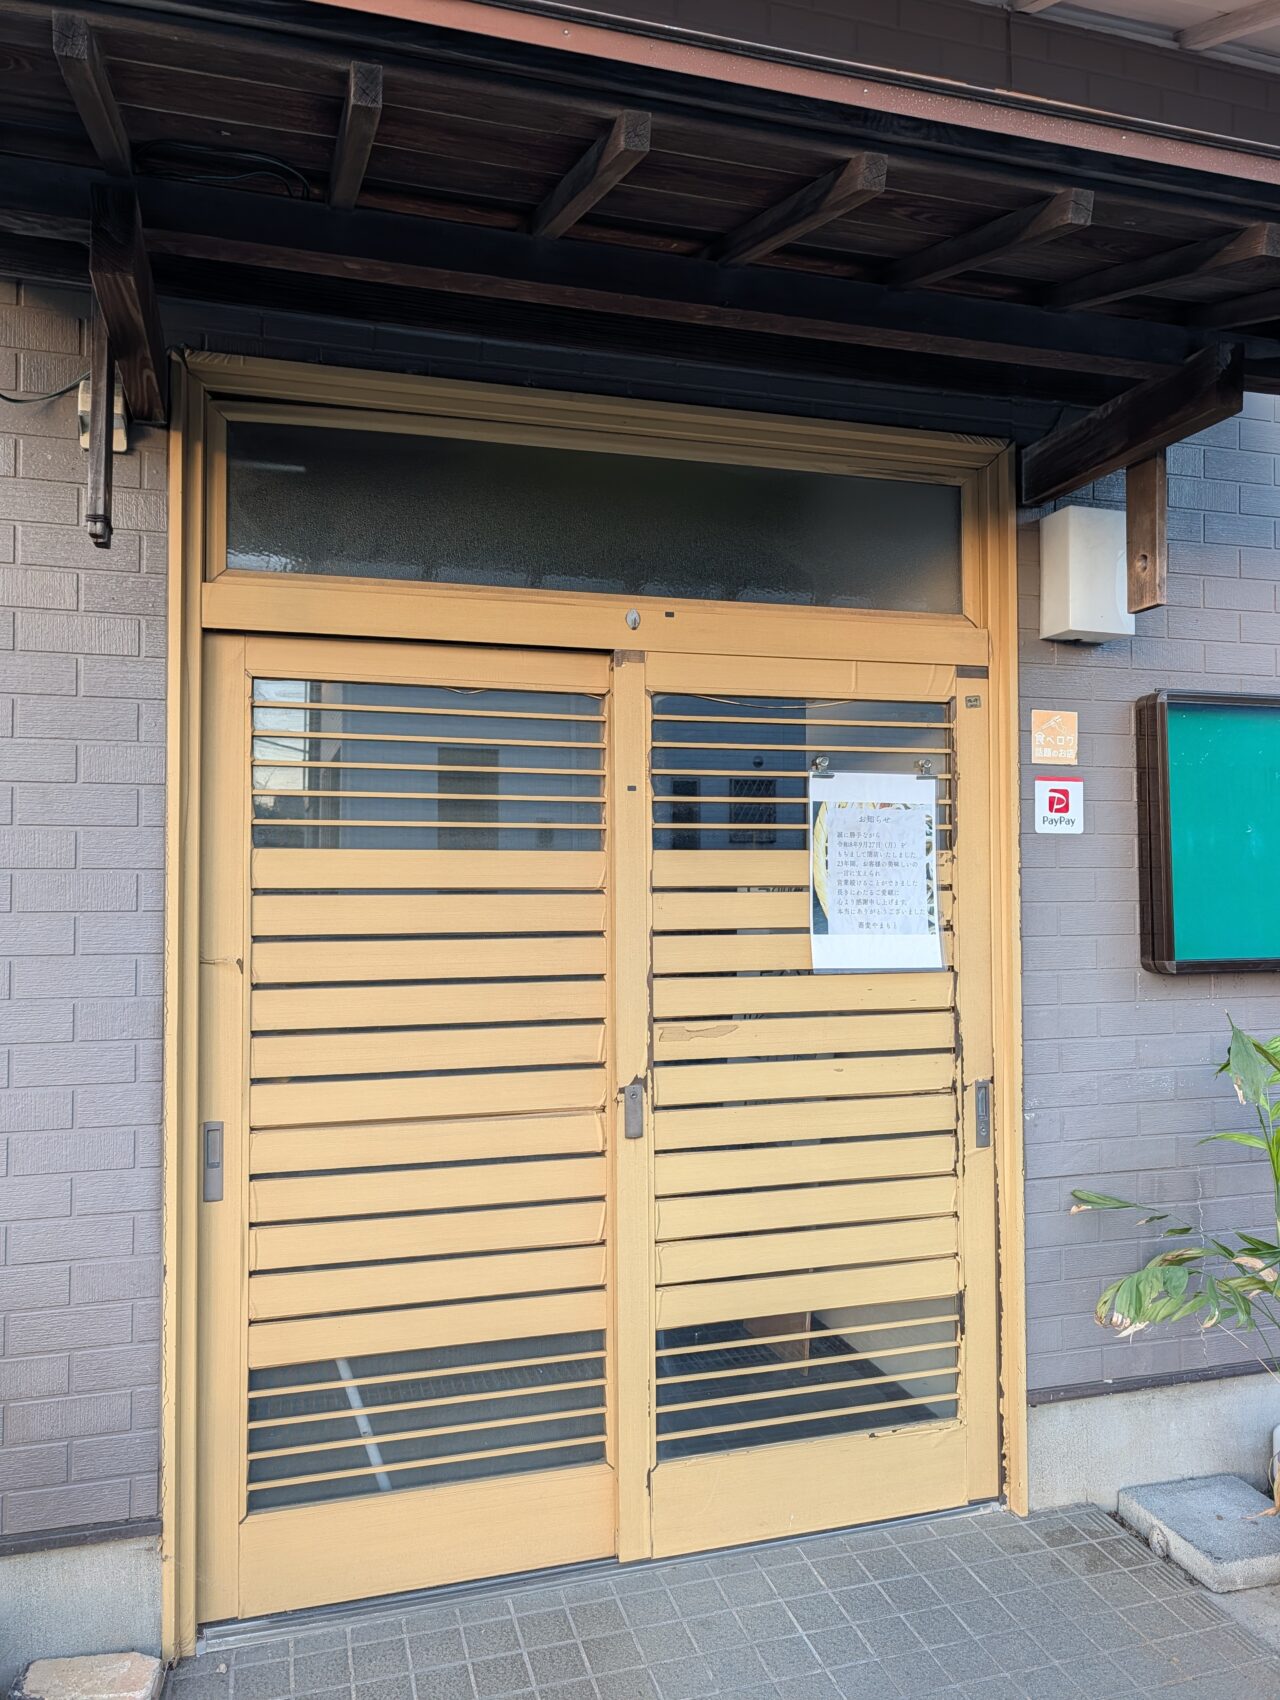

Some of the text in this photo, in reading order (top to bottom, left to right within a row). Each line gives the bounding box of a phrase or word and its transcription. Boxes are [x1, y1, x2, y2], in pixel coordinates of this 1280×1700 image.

[858, 815, 892, 823] お知らせ
[1042, 816, 1075, 827] PayPay
[837, 831, 881, 839] 誠に勝手ながら
